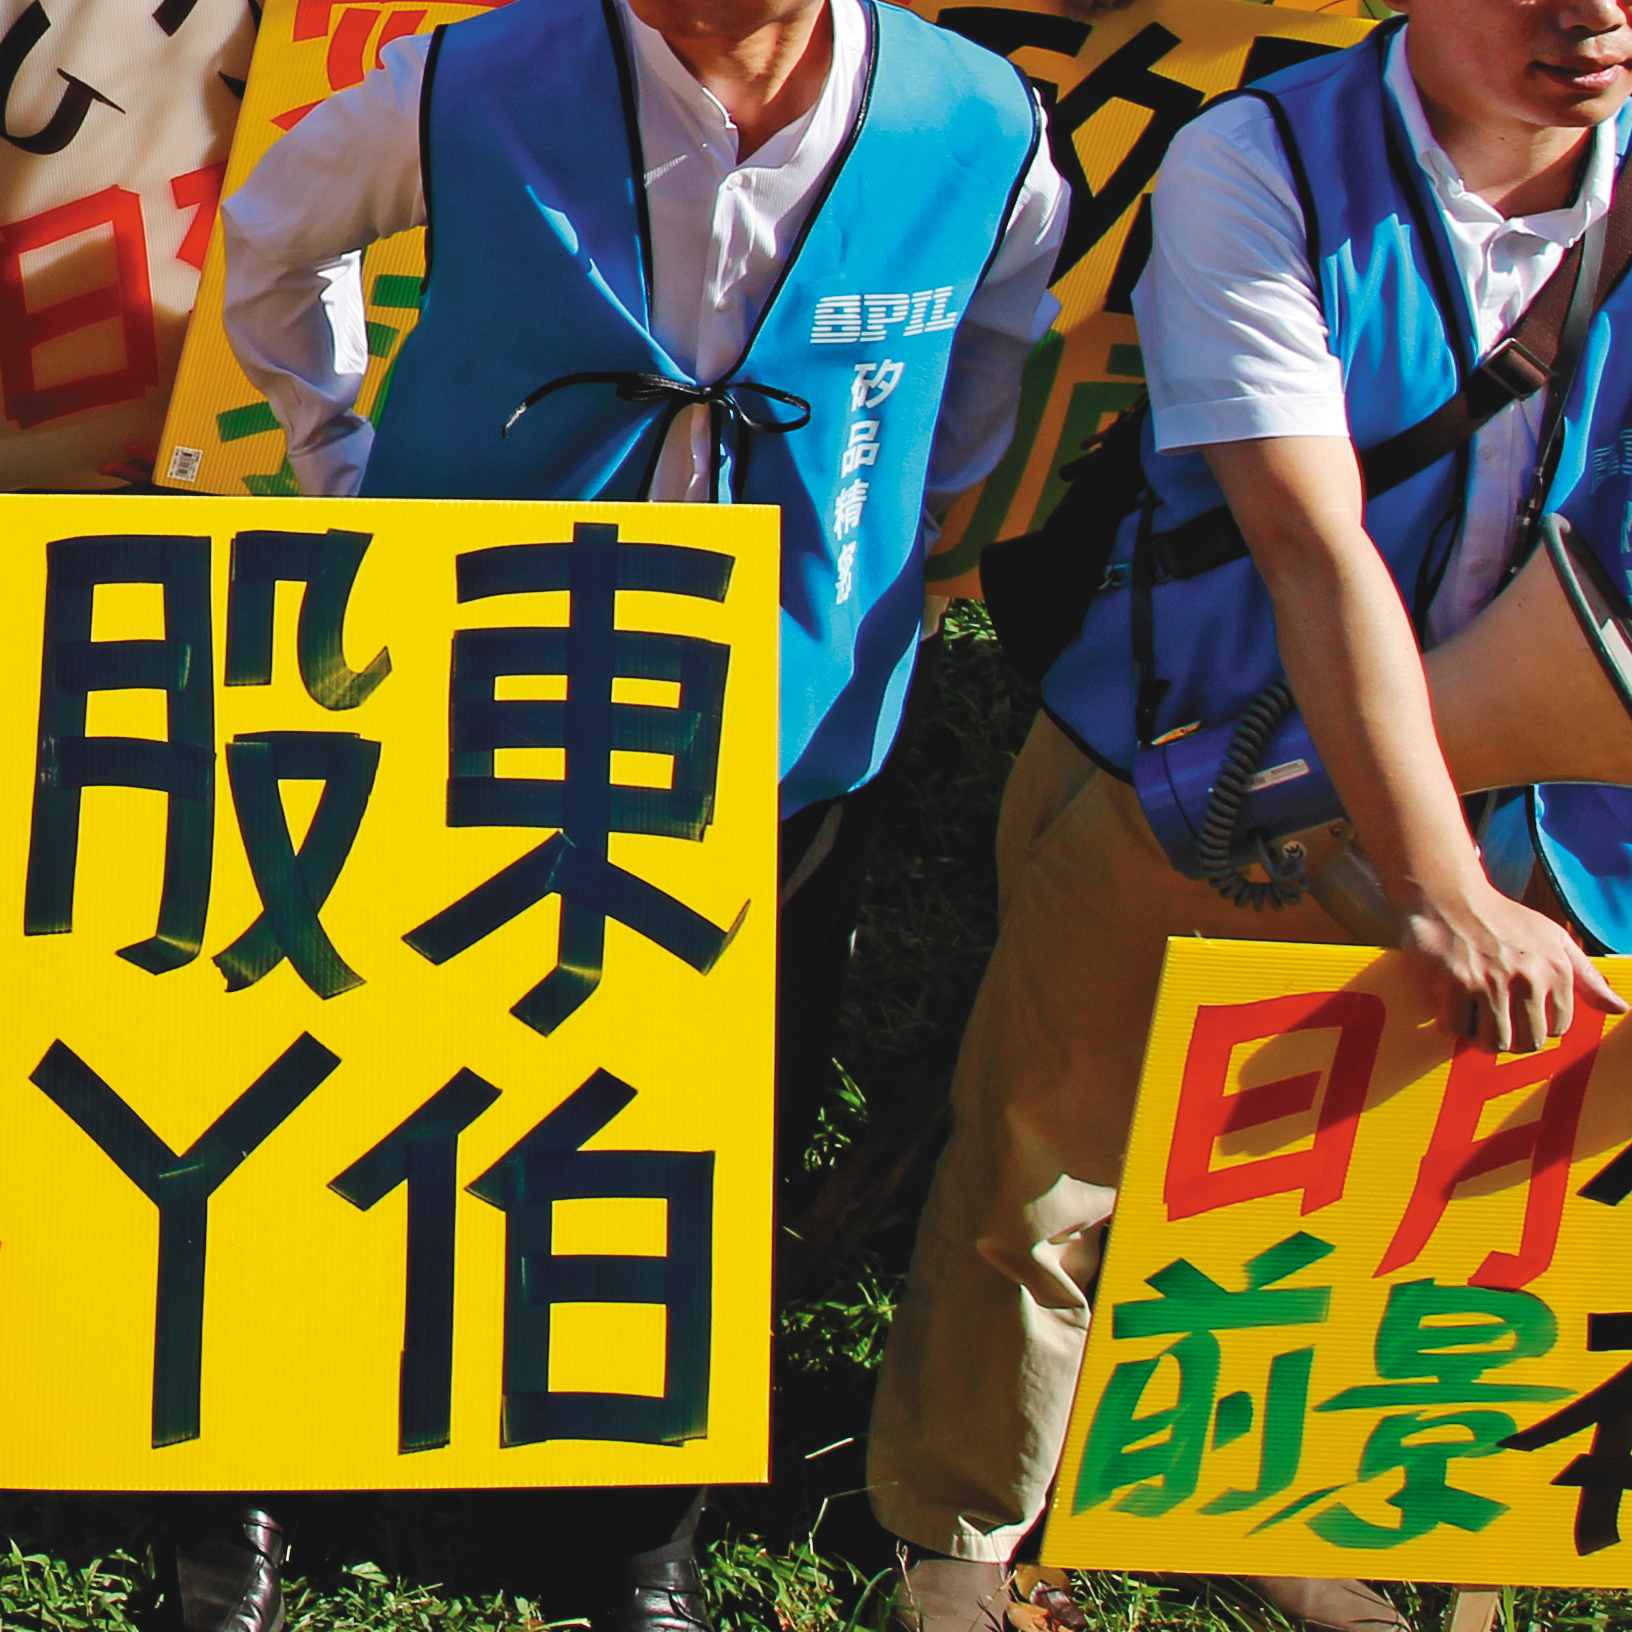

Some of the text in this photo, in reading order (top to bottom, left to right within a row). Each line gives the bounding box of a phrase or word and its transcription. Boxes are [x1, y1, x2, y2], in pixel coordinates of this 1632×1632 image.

[809, 285, 958, 347] SPIL
[833, 357, 905, 607] 矽品精密
[1161, 980, 1632, 1292] 日月
